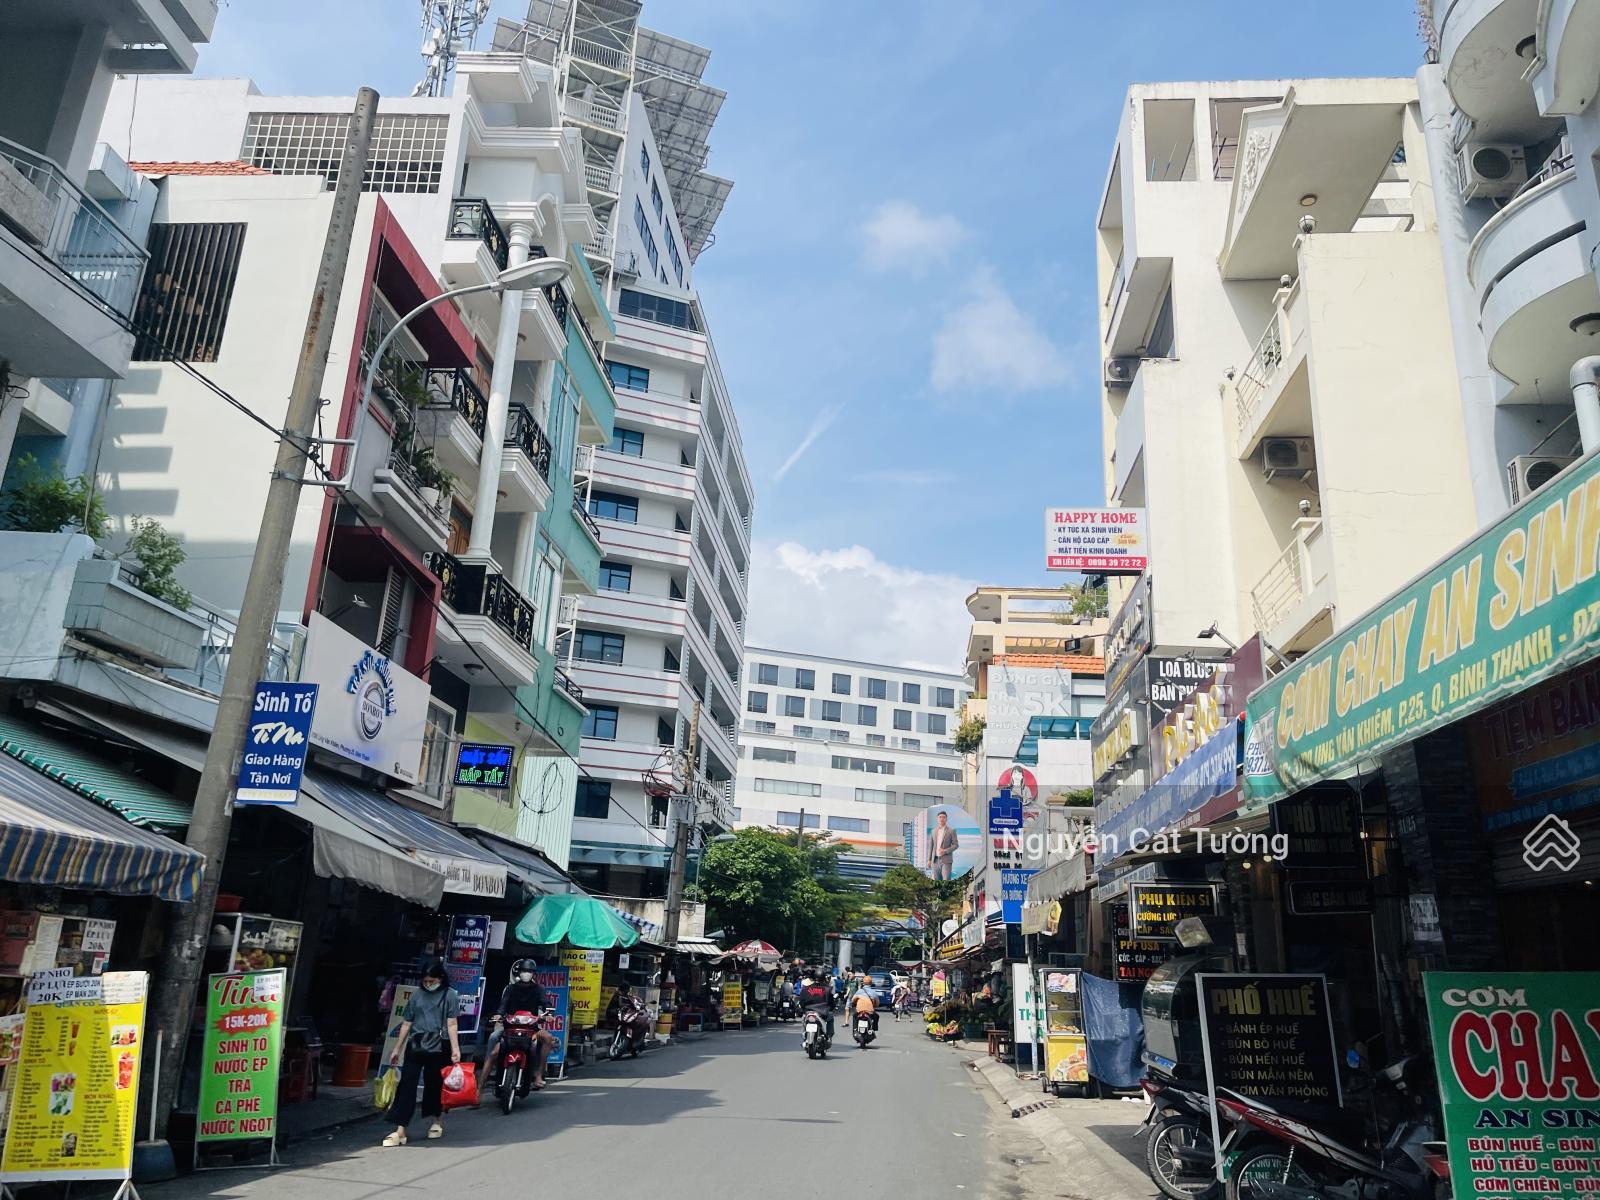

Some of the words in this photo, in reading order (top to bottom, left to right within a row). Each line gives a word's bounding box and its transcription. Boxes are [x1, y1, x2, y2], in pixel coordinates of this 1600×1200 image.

[1054, 512, 1097, 523] HAPPY
[1100, 512, 1137, 524] HOME
[1091, 526, 1106, 534] SINH
[1083, 535, 1095, 544] CAO
[1089, 547, 1104, 555] KINH
[1106, 547, 1127, 555] DOANH
[1108, 558, 1118, 567] 39
[1120, 559, 1130, 567] 72
[1131, 559, 1141, 567] 72
[1277, 655, 1333, 749] CƠM
[1335, 597, 1417, 718] CHAY
[1418, 553, 1483, 673] AN
[1159, 661, 1181, 678] LOA
[1357, 706, 1395, 748] KHIÊM,
[1431, 682, 1444, 709] Q.
[1449, 659, 1487, 702] BÌNH
[1491, 624, 1553, 683] THẠNH
[254, 691, 290, 713] Sinh
[294, 691, 315, 713] Tố
[1024, 691, 1071, 717] 5K
[244, 753, 271, 765] Giao
[272, 754, 302, 769] Hàng
[249, 771, 269, 787] Tận
[271, 773, 292, 785] Nơi
[459, 765, 482, 782] HẤP
[1139, 892, 1164, 908] PHỤ
[1136, 911, 1162, 922] CƯỜNG
[48, 969, 71, 978] NHO
[1120, 966, 1137, 978] TAI
[36, 992, 62, 1003] 20K
[1210, 981, 1262, 1015] PHỐ
[1266, 982, 1316, 1016] HUẾ
[1441, 985, 1528, 1007] CƠM
[224, 1013, 268, 1029] 15K-20K
[1225, 1022, 1257, 1034] BÁNH
[1276, 1020, 1300, 1034] HUẾ
[218, 1039, 249, 1055] SINH
[1227, 1037, 1251, 1049] BÚN
[1253, 1037, 1270, 1049] BÒ
[1273, 1036, 1296, 1050] HUẾ
[213, 1057, 248, 1075] NƯỚC
[1229, 1053, 1253, 1065] BÚN
[1281, 1051, 1305, 1065] HUẾ
[1231, 1069, 1255, 1080] BÚN
[228, 1077, 251, 1093] TRÀ
[1260, 1084, 1285, 1096] VĂN
[1287, 1083, 1329, 1097] PHÒNG
[235, 1095, 261, 1113] PHÊ
[200, 1119, 235, 1136] NƯỚC
[239, 1117, 273, 1135] NGỌT
[1474, 1108, 1531, 1129] AN
[1468, 1135, 1505, 1152] BÚN
[1508, 1134, 1544, 1152] HUẾ
[1558, 1135, 1595, 1152] BÚN
[1470, 1154, 1496, 1172] HỦ
[1498, 1154, 1537, 1172] TIẾU
[1552, 1155, 1590, 1172] BÚN
[1473, 1176, 1511, 1193] CƠM
[1513, 1175, 1561, 1193] CHIÊN
